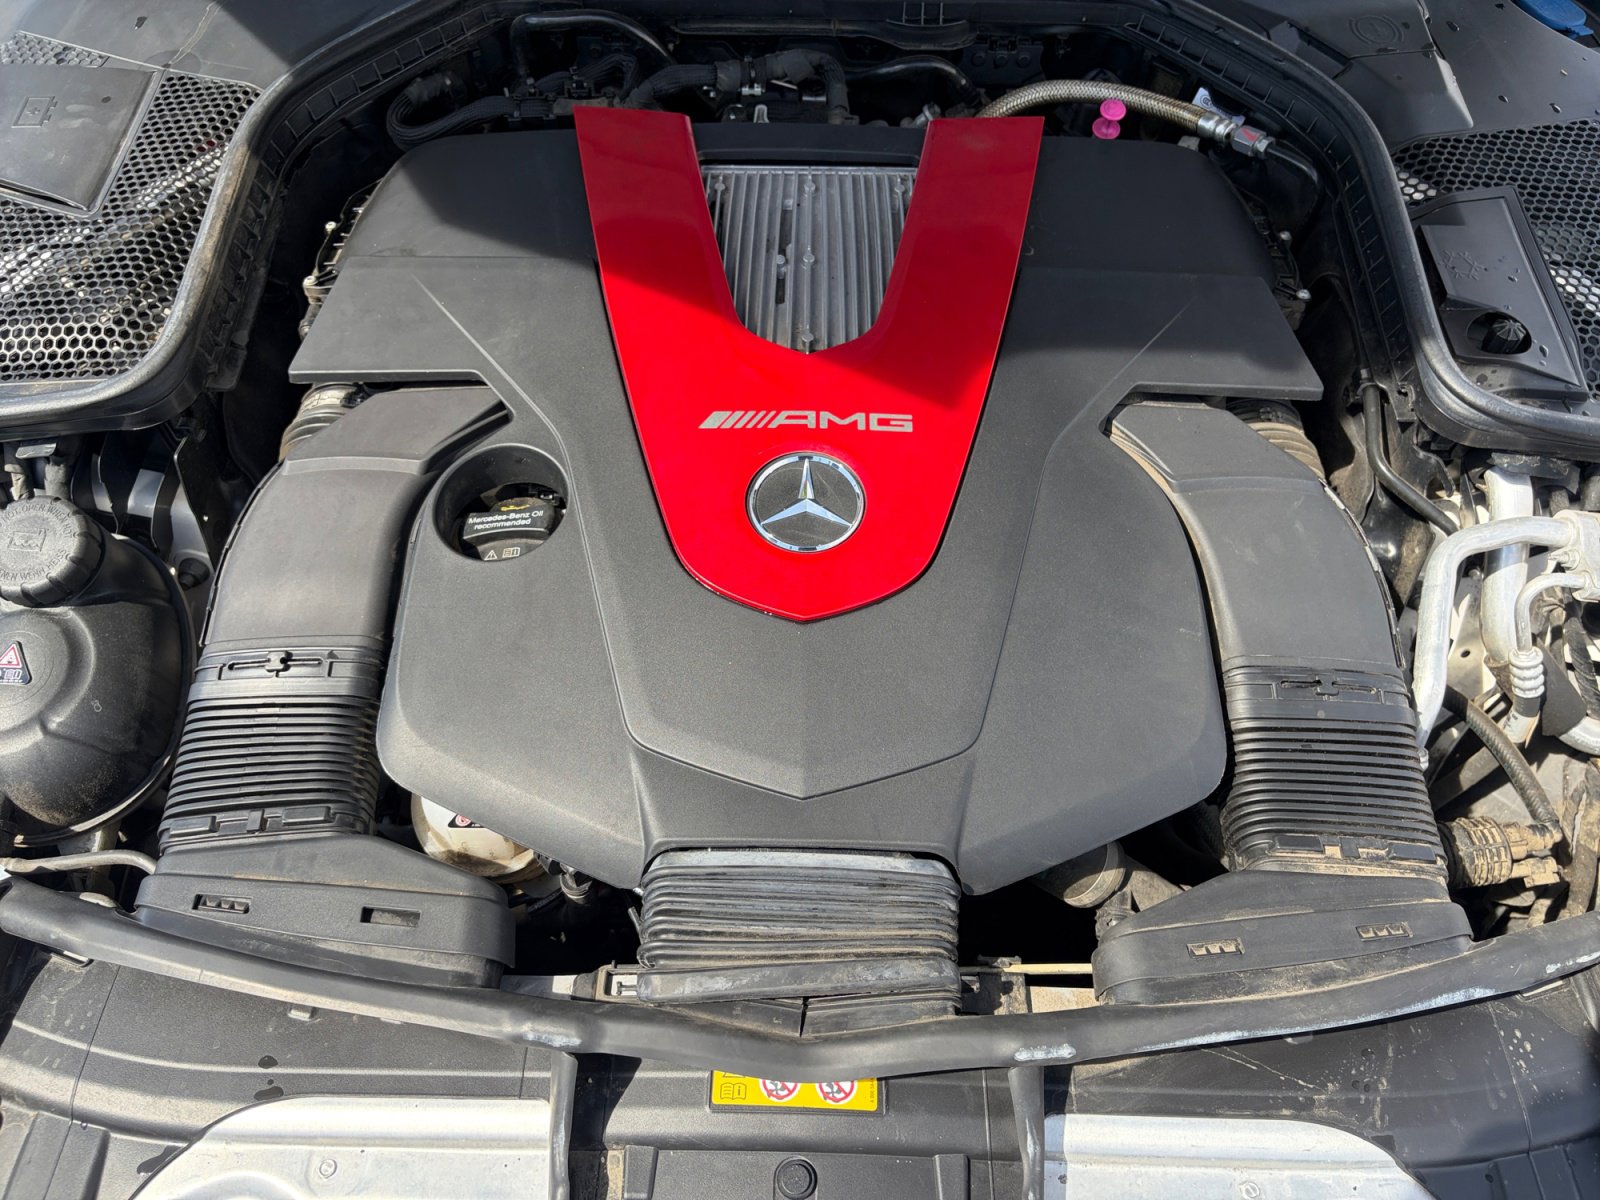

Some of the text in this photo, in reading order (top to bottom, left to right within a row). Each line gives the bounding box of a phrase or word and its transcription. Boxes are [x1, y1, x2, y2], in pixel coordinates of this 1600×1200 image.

[767, 410, 913, 432] AMG
[468, 513, 530, 524] Mercedes-Benz
[474, 519, 531, 530] recommended
